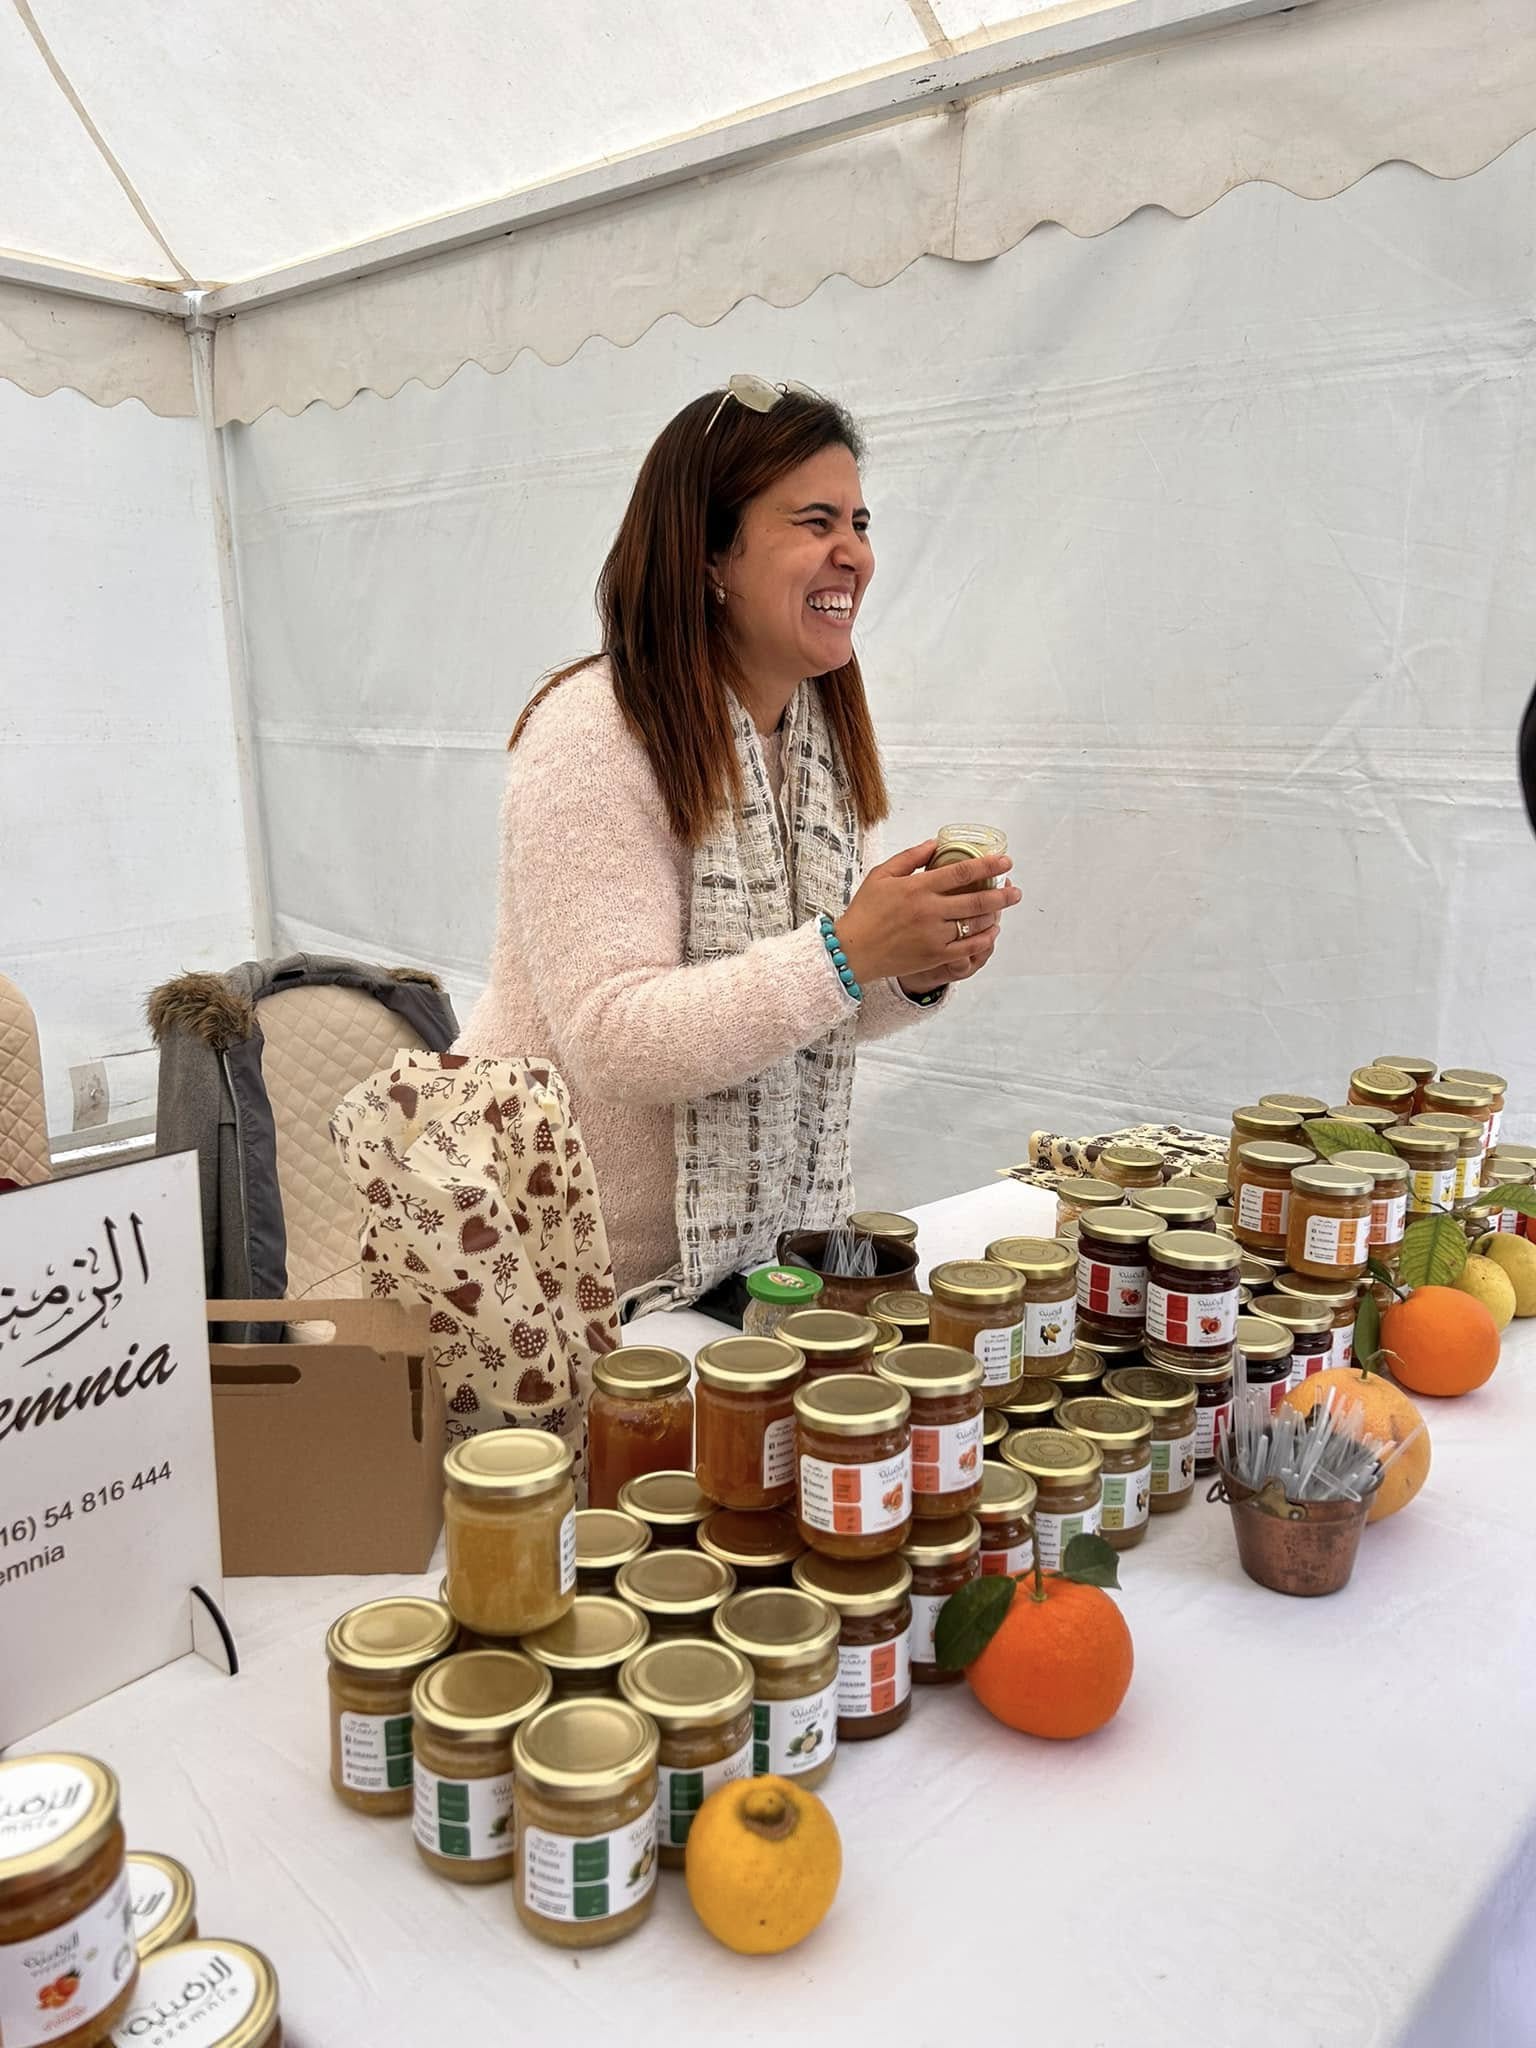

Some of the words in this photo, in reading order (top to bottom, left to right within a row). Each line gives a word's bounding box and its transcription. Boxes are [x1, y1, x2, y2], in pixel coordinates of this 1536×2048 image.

[0, 1212, 149, 1368] الزمن
[0, 1516, 37, 1547] 16)
[44, 1501, 74, 1529] 54
[81, 1480, 125, 1513] 816
[131, 1461, 172, 1491] 444
